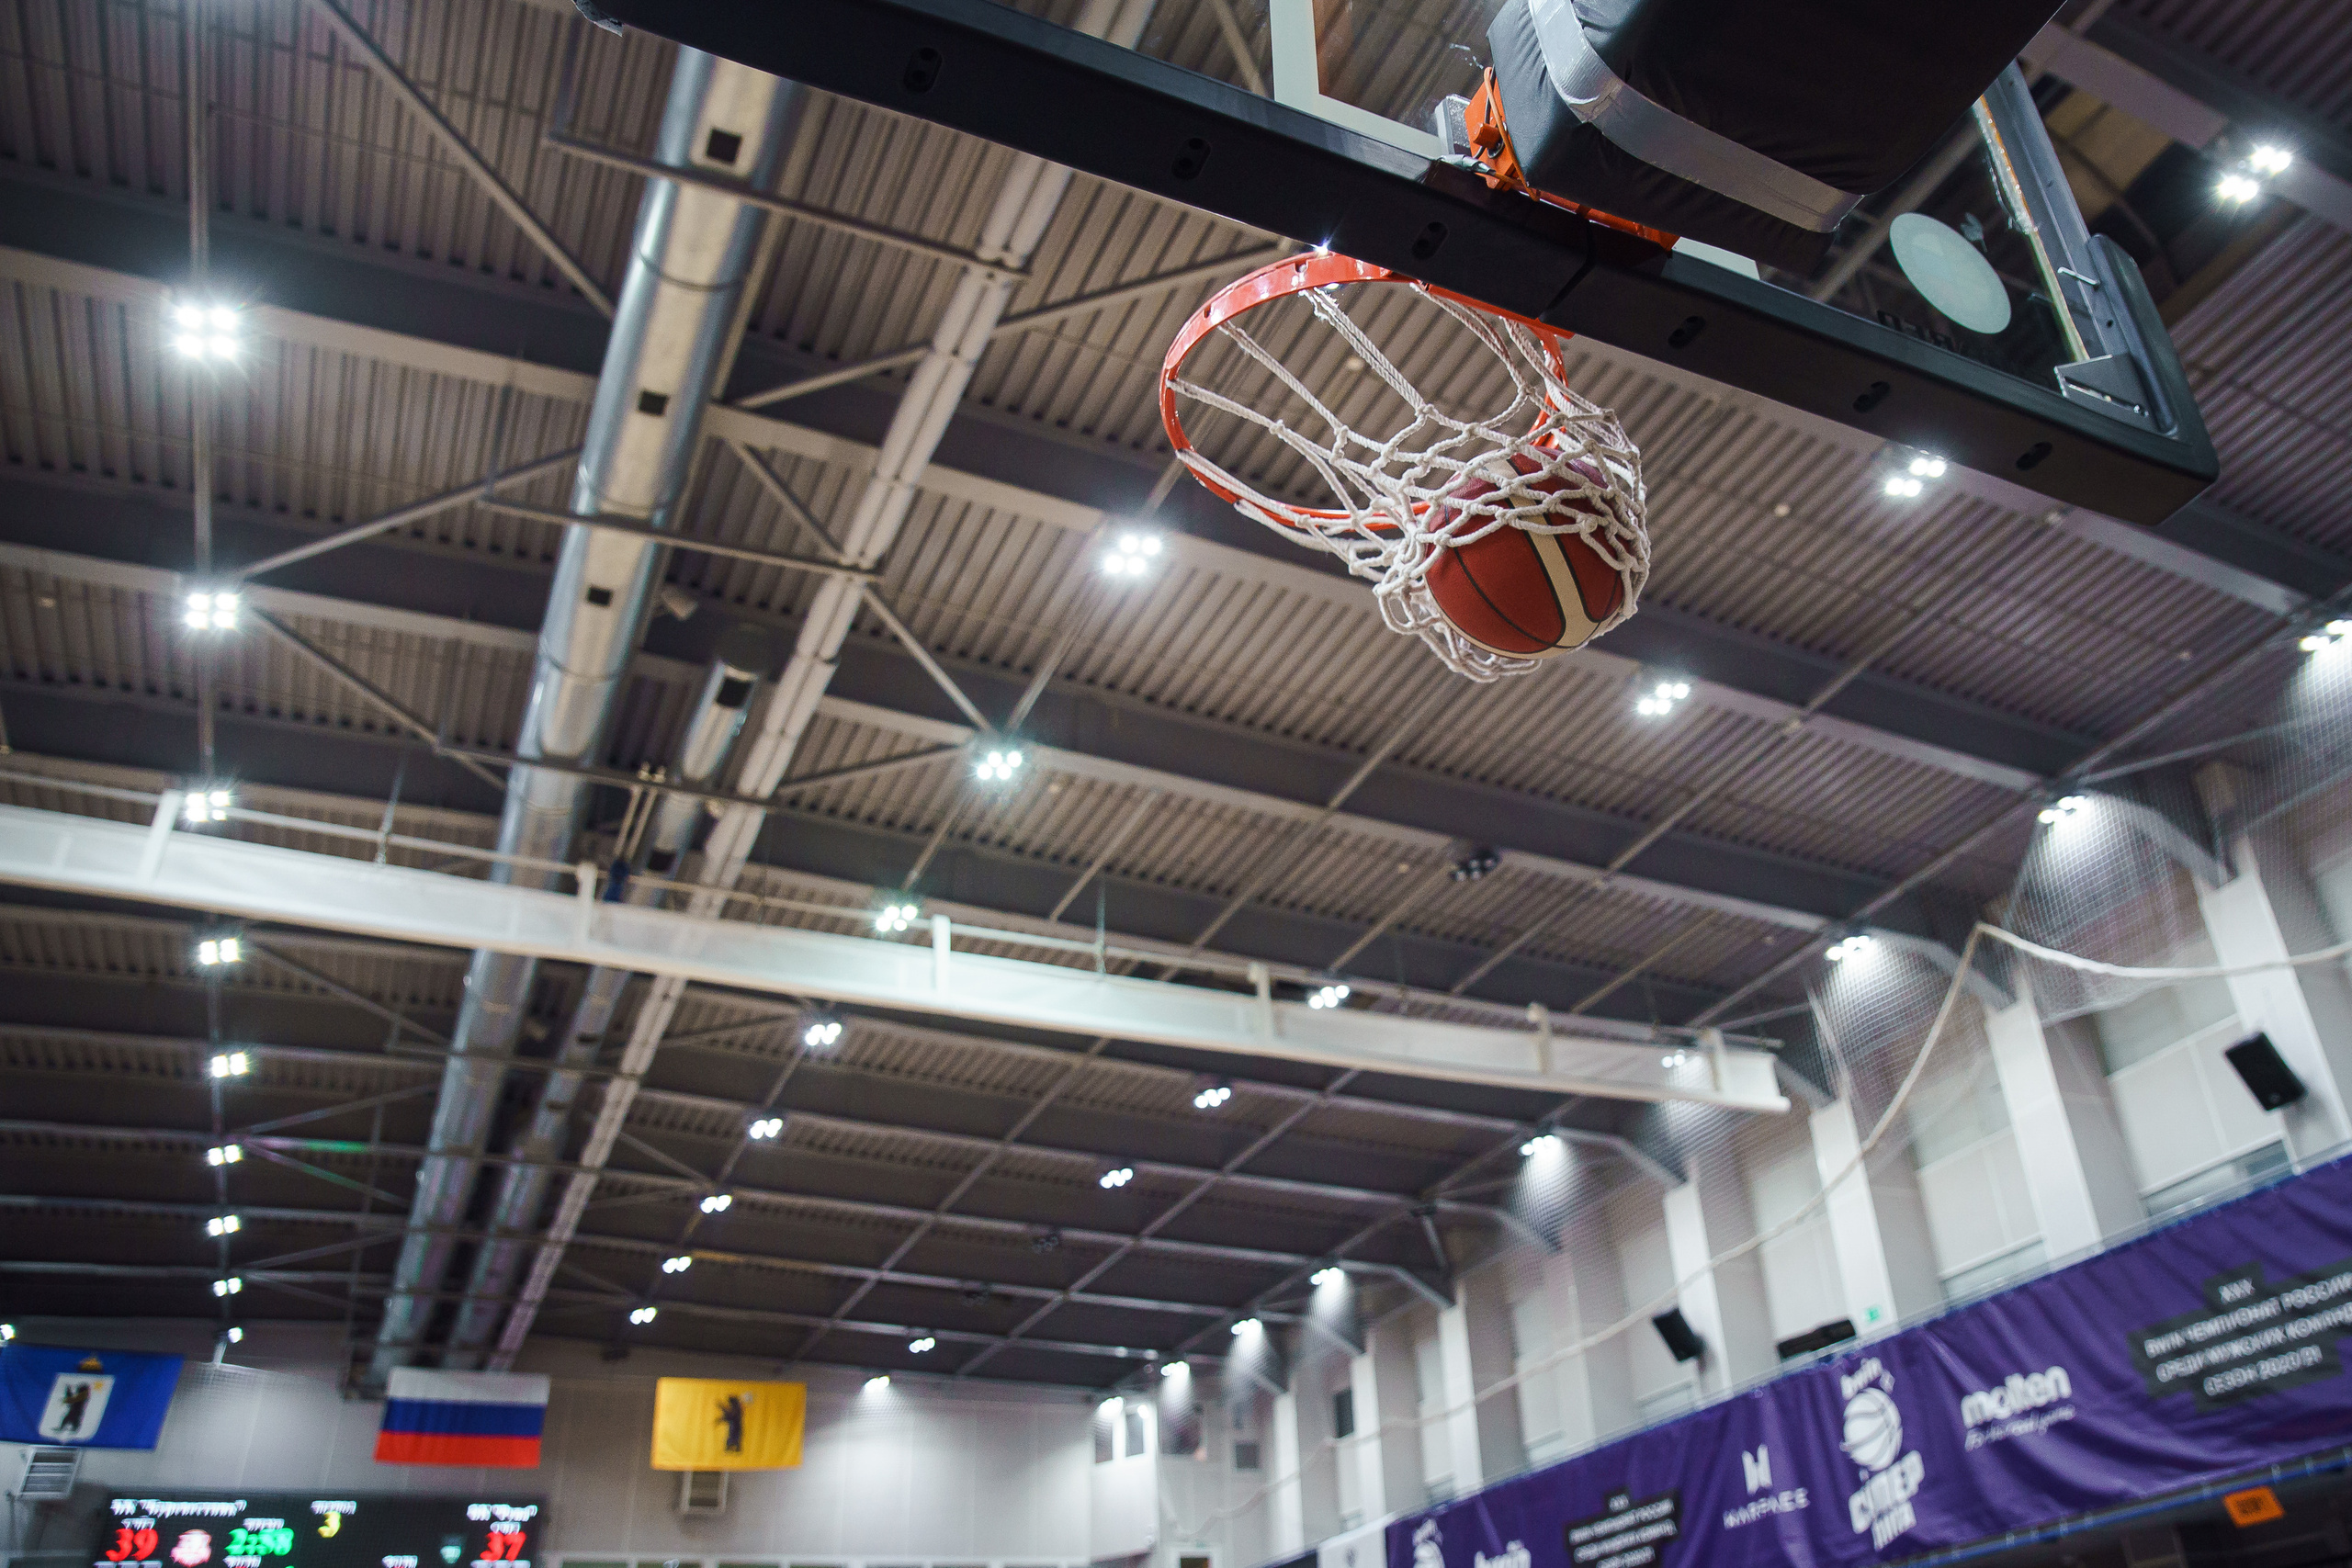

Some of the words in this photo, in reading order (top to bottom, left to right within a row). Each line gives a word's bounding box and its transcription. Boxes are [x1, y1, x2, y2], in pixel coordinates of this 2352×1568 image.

[1961, 1365, 2072, 1428] molten
[318, 1511, 341, 1538] 3
[106, 1528, 158, 1562] 39
[480, 1531, 526, 1562] 37
